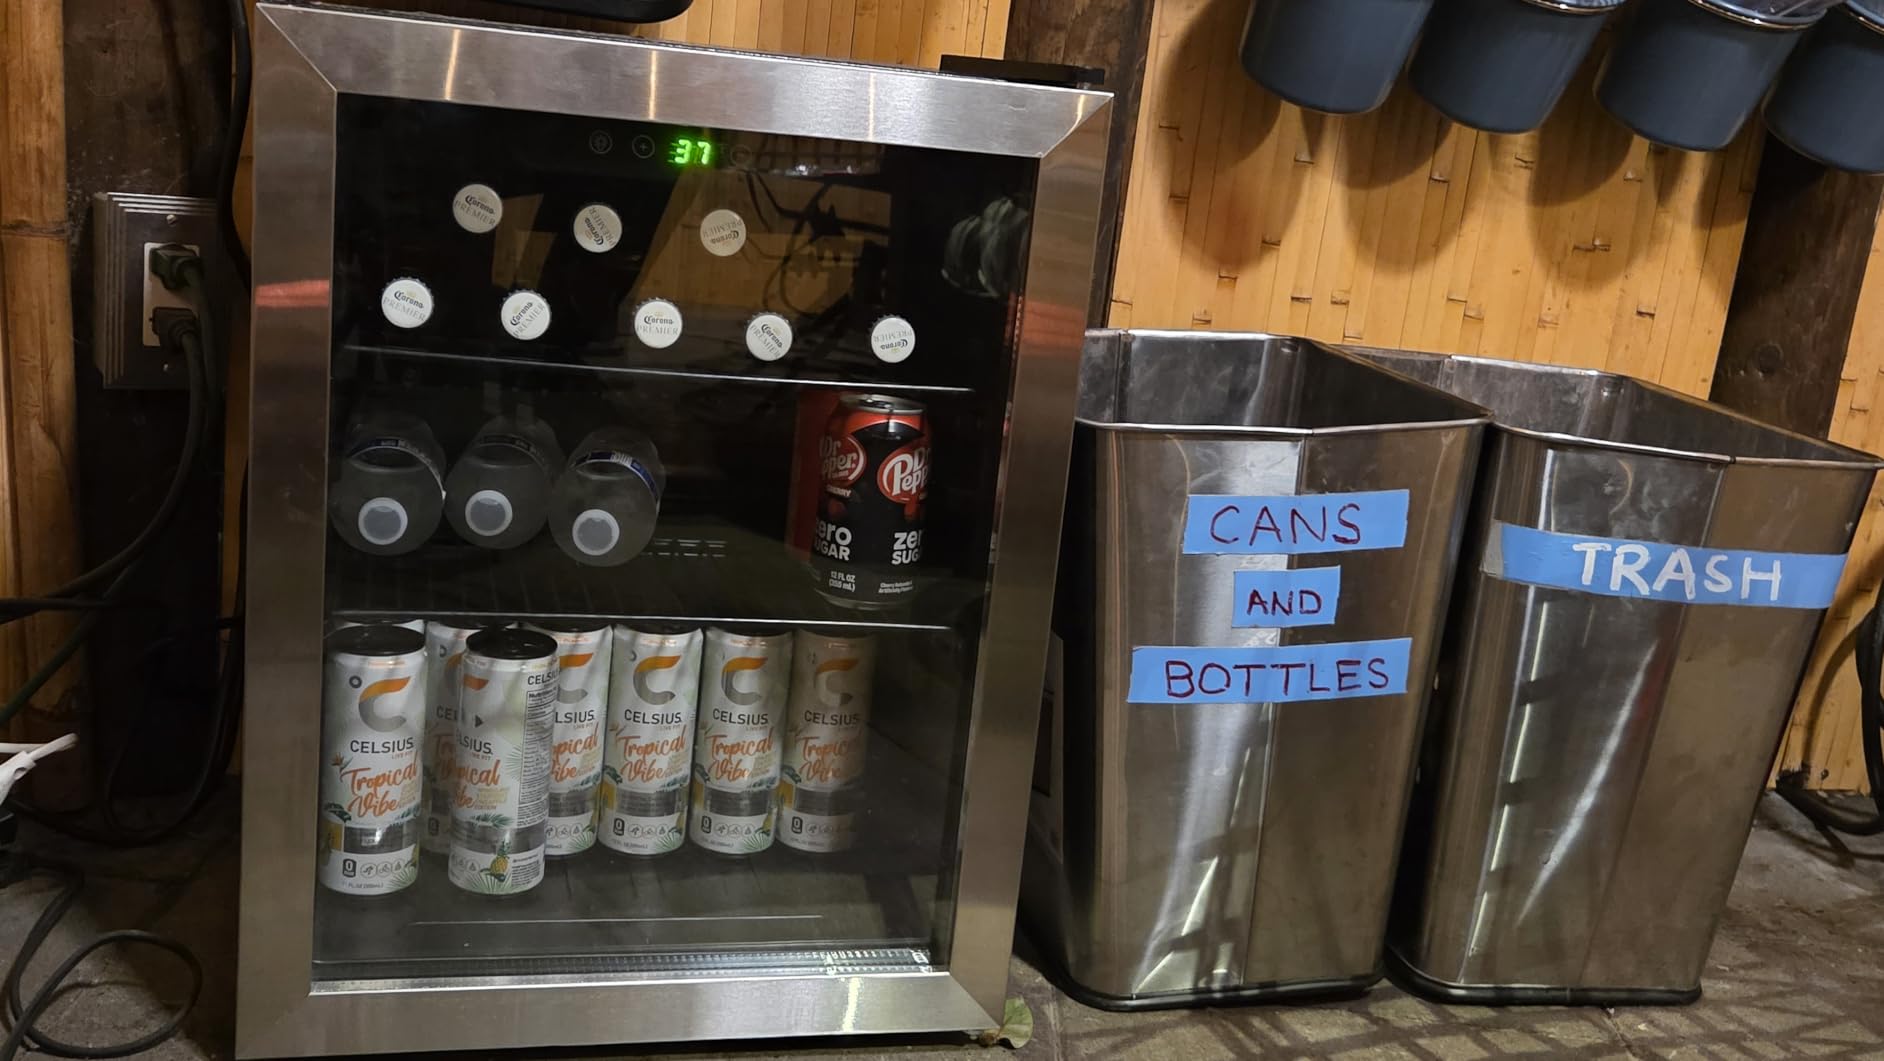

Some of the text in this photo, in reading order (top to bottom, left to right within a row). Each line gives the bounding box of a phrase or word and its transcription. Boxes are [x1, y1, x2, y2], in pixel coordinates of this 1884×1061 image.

[673, 138, 711, 165] 37
[454, 200, 496, 226] PREMIER
[465, 194, 496, 215] Corona
[584, 217, 604, 246] Corona
[589, 208, 616, 247] PREMIER
[702, 219, 743, 238] PREMIER
[710, 230, 740, 244] Corona
[382, 296, 426, 321] PREMIER
[394, 290, 424, 309] Corona
[510, 302, 533, 326] Corona
[512, 303, 545, 338] PREMIER
[643, 315, 674, 325] Corona
[636, 325, 679, 335] PREMIER
[749, 324, 781, 358] PREMIER
[761, 323, 783, 348] Corona
[873, 329, 912, 342] PREMIER
[880, 338, 908, 350] Corona
[816, 519, 853, 546] ero
[1210, 503, 1361, 547] CANS
[815, 537, 851, 561] UGAR
[891, 548, 920, 566] SUG
[1572, 542, 1782, 602] TRASH
[1246, 589, 1322, 616] AND
[1165, 657, 1389, 699] BOTTLES
[555, 709, 595, 724] LSIUS
[624, 709, 682, 725] CELSIUS
[713, 708, 769, 725] CELSIUS
[804, 710, 860, 726] CELSIUS
[350, 737, 414, 754] CELSIUS
[617, 724, 687, 764] Tropical
[705, 726, 774, 761] Tropical
[340, 751, 418, 798] Tropical
[551, 758, 577, 784] ibe
[620, 759, 666, 783] Vibe
[708, 759, 752, 782] Vibe
[347, 791, 399, 818] Vibe
